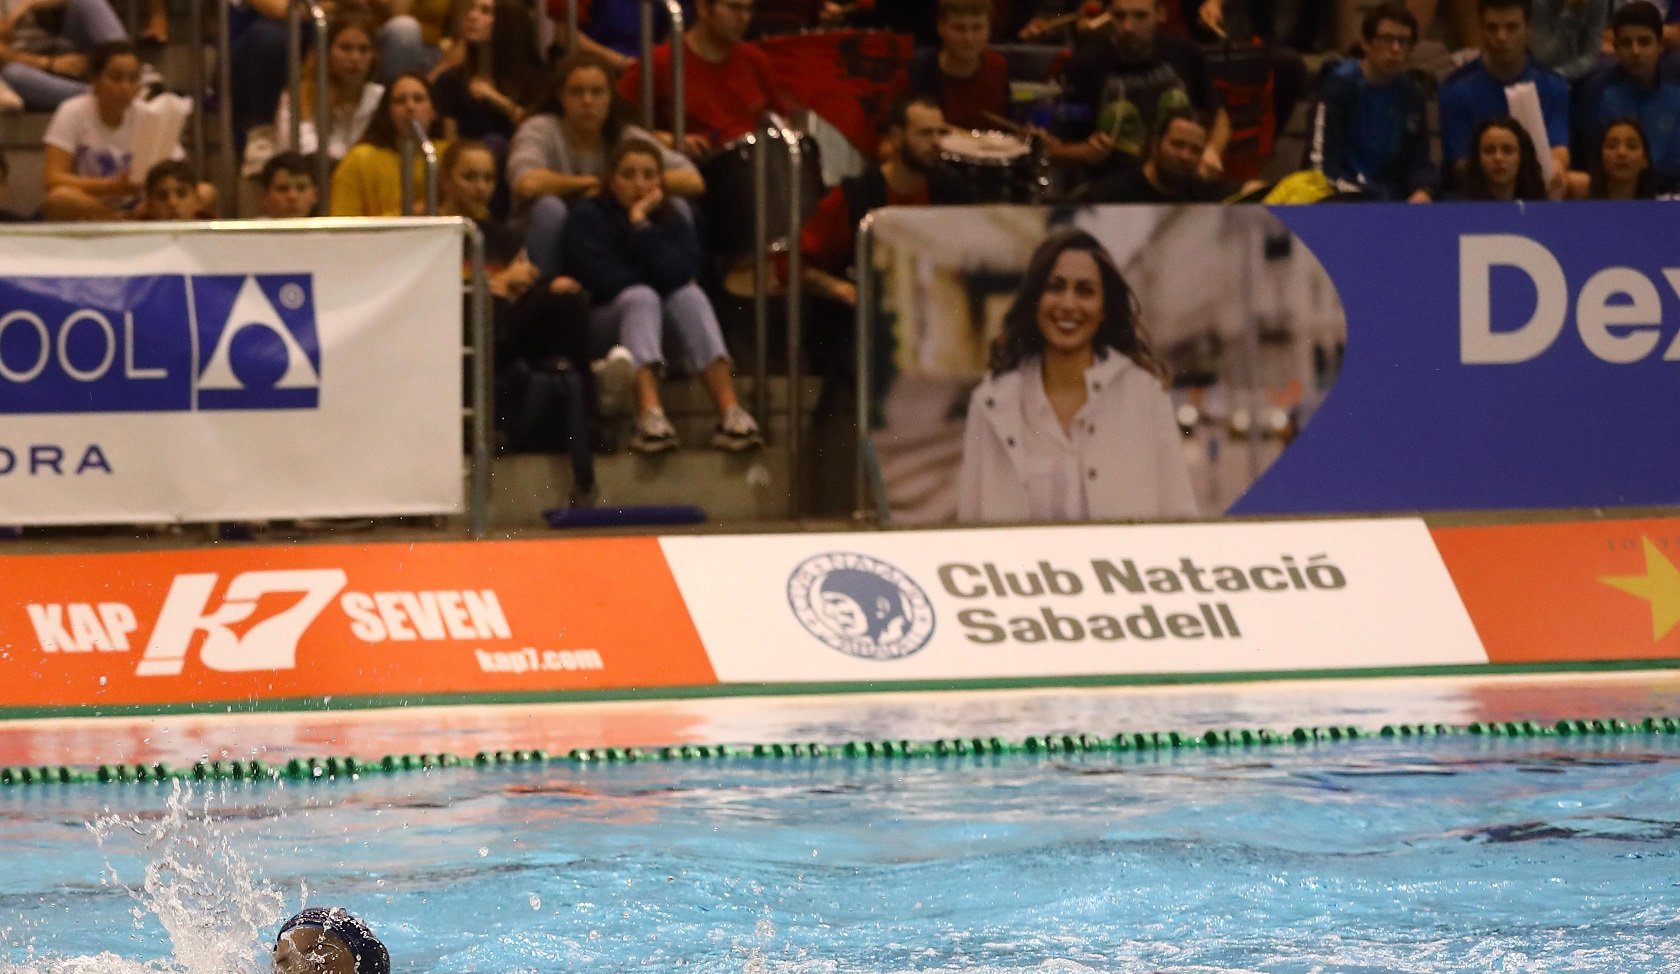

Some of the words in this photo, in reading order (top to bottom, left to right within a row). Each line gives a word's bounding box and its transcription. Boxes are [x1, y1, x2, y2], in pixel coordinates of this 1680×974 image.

[1459, 233, 1680, 365] De
[937, 562, 1085, 600] Club
[1092, 553, 1348, 592] Natació
[26, 602, 138, 653] KAP
[340, 589, 512, 643] SEVEN
[957, 602, 1244, 646] Sabadell
[474, 646, 605, 674] kap7.com
